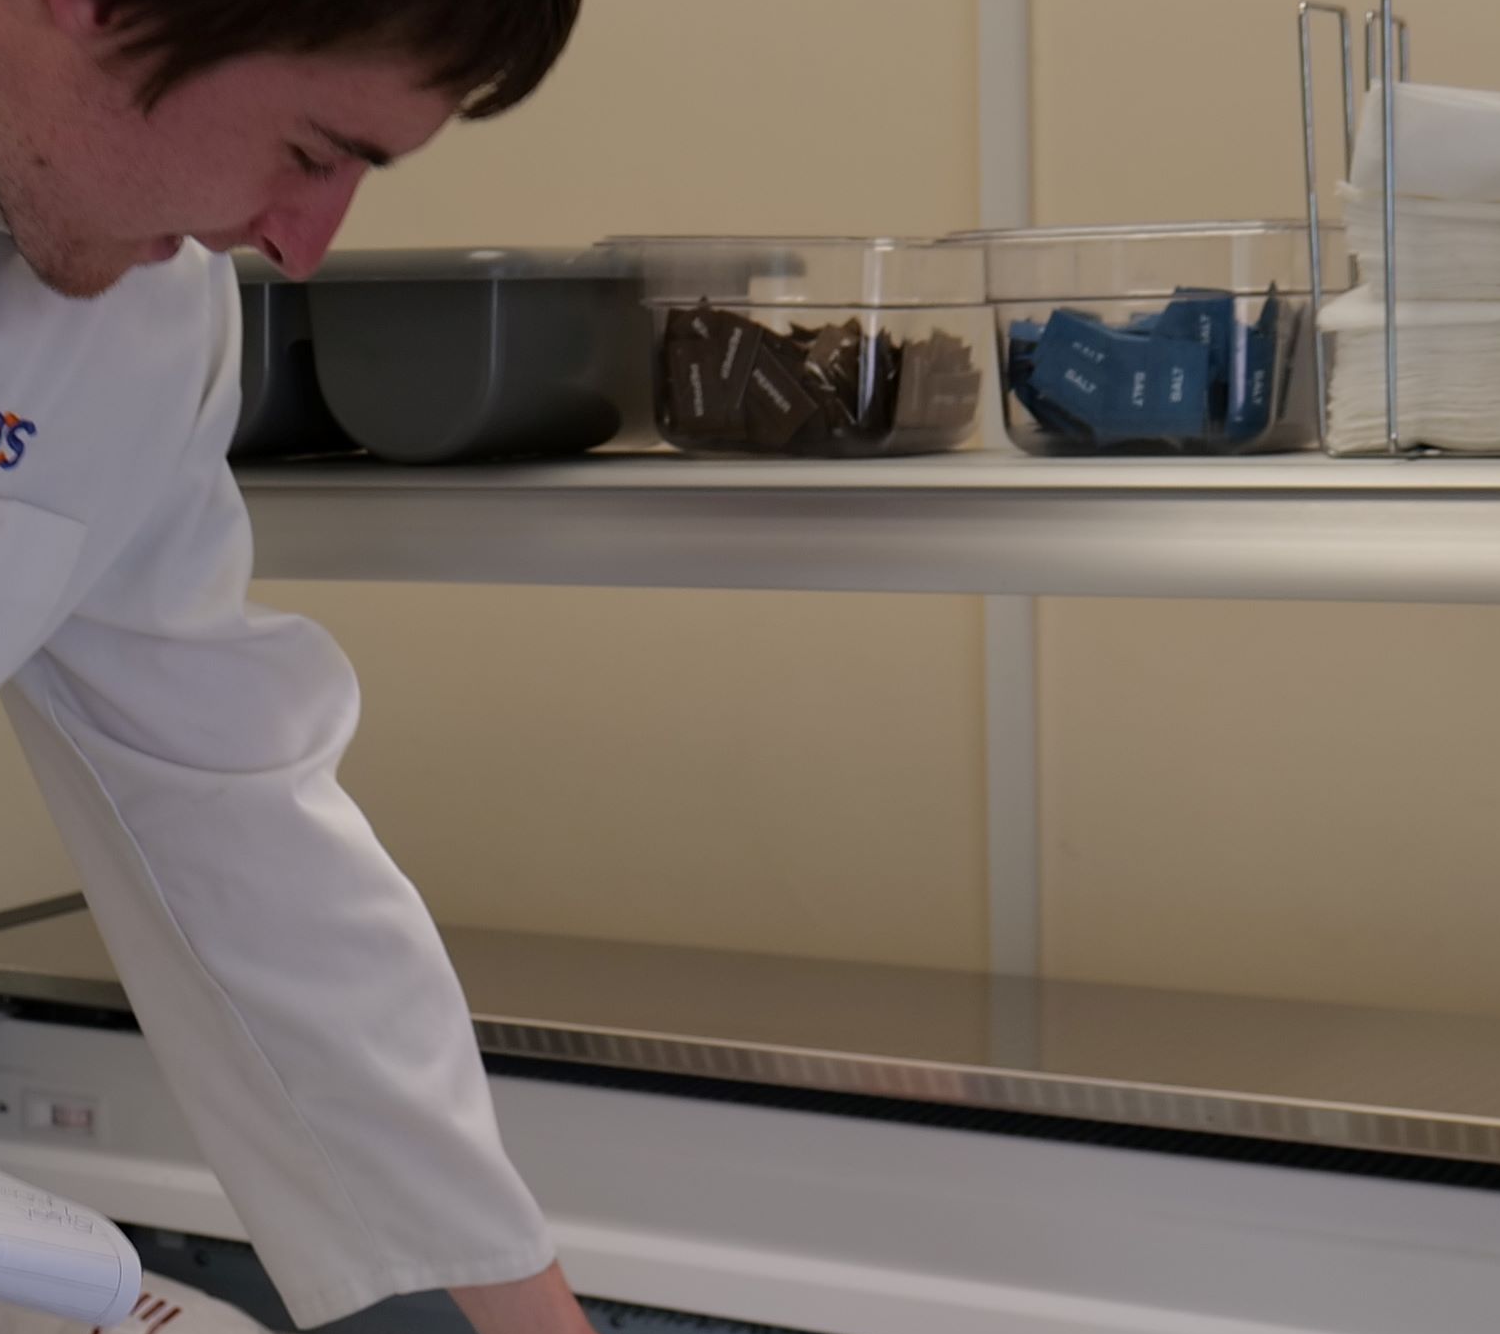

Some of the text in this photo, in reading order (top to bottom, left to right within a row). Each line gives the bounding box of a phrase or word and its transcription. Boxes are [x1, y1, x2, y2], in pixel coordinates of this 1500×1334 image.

[1063, 368, 1098, 395] SALT
[1131, 370, 1148, 409] SALT
[1169, 365, 1185, 405] SALT
